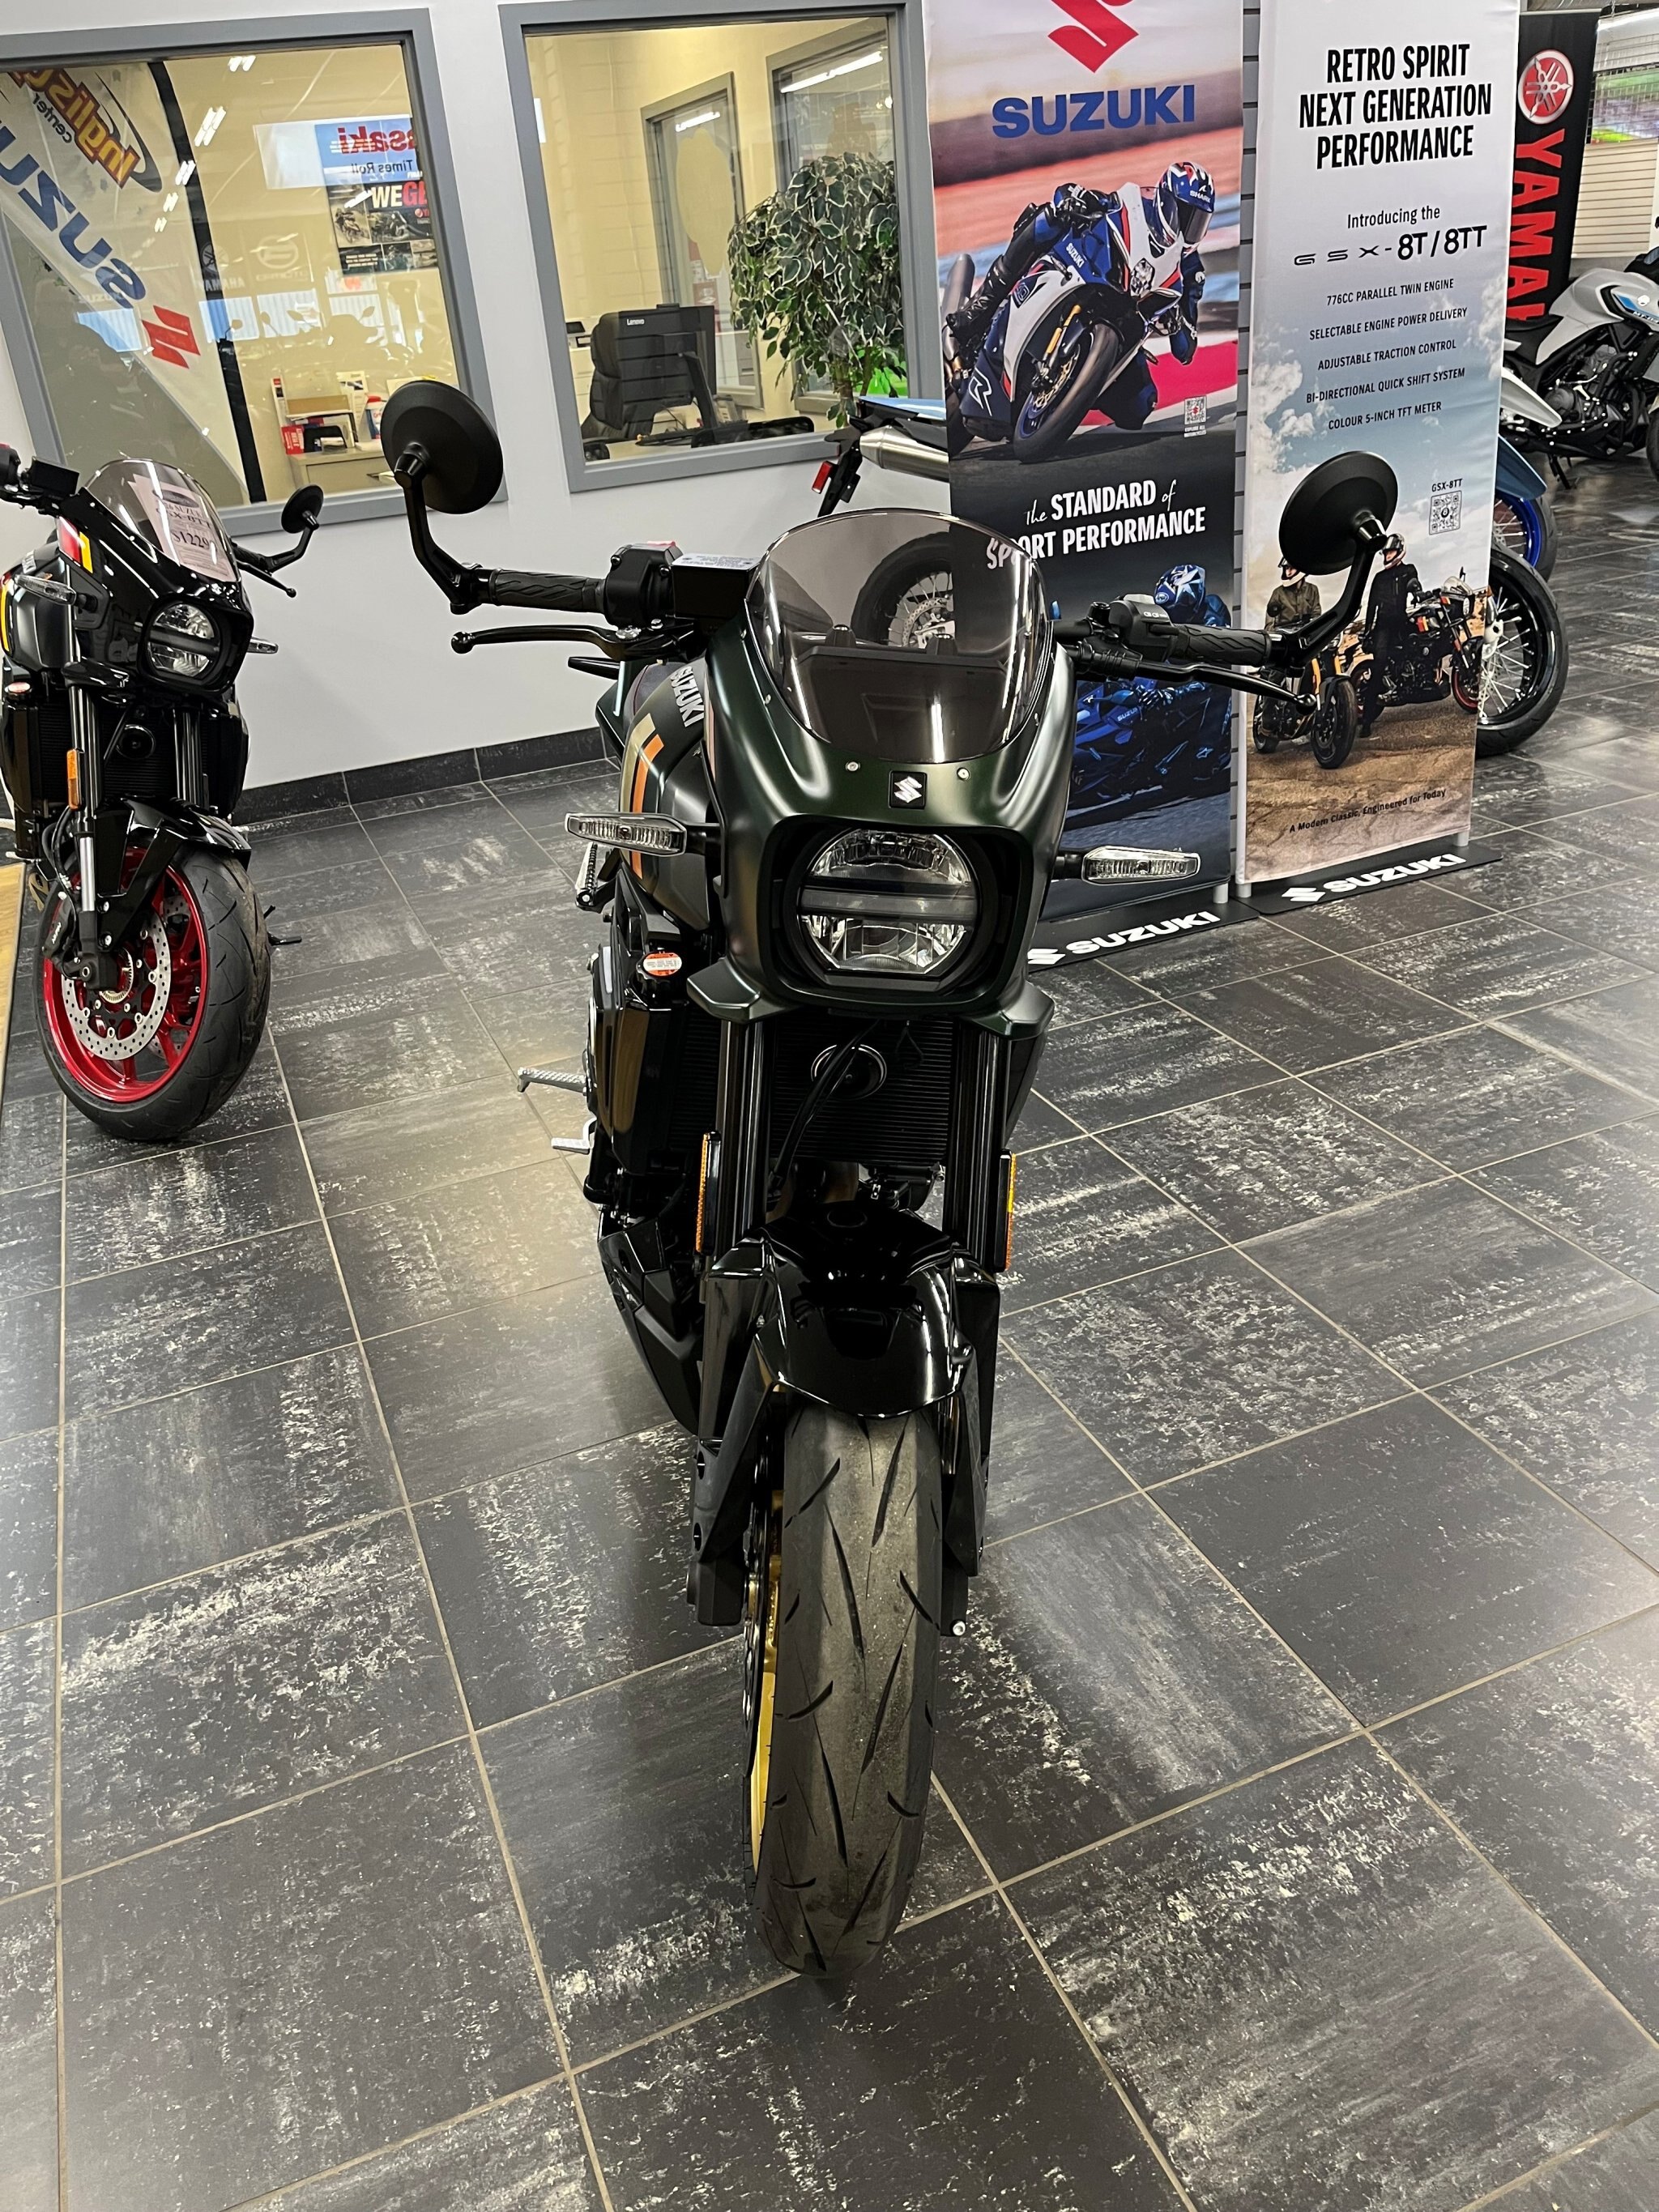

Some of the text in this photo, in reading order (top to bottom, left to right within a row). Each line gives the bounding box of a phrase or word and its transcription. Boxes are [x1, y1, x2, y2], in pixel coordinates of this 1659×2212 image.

[1327, 44, 1470, 83] RETRO SPIRIT
[992, 85, 1195, 139] SUZUKI
[1299, 83, 1491, 128] NEXT GENERATION
[1316, 125, 1474, 169] PERFORMANCE
[1189, 190, 1212, 202] SHARK
[1347, 205, 1440, 229] Introducing the
[1065, 243, 1085, 268] SUZUKI
[1327, 279, 1454, 305] 776CC PARALLEL TWIN ENGINE
[1309, 307, 1468, 340] SELECTABLE ENGINE POWER DELIVERY
[1318, 339, 1456, 370] ADJUSTABLE TRACTION CONTROL
[1306, 368, 1465, 403] BI-DIRECTIONAL QUICK SHIFT SYSTEM
[1328, 402, 1442, 430] COLOUR 5-INCH TFT METER
[1051, 479, 1156, 521] STANDARD
[1161, 479, 1177, 511] of
[1431, 478, 1463, 492] GSX-8TT
[1062, 507, 1206, 554] PERFORMANCE
[670, 666, 705, 727] SUZUKI
[1289, 789, 1446, 833] A Modern Classic, Engineered for Today
[1324, 854, 1467, 893] SUZUKI
[1066, 910, 1221, 955] SUZUKI
